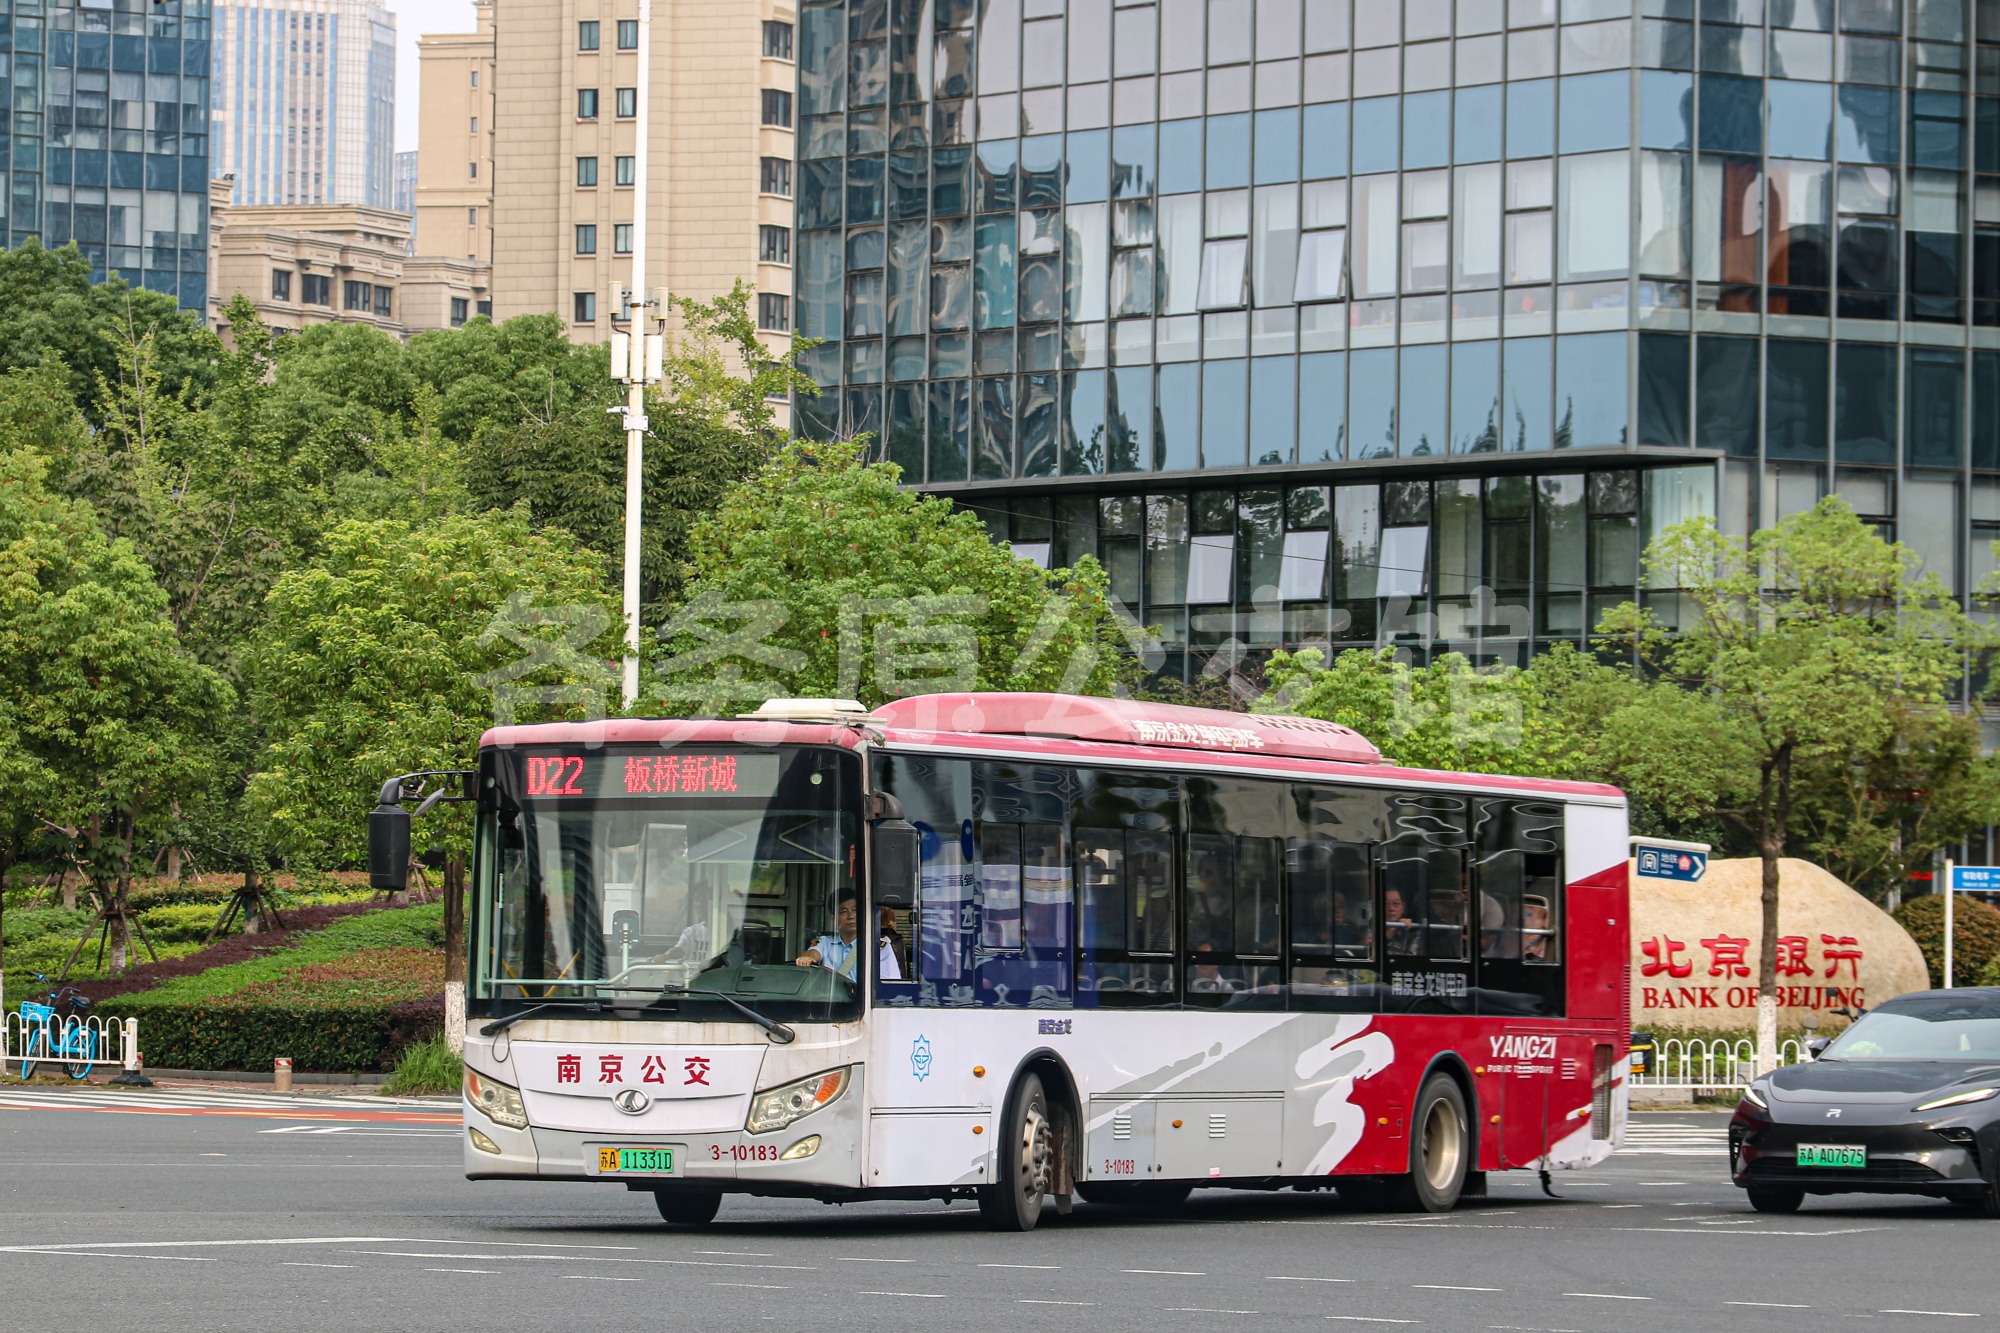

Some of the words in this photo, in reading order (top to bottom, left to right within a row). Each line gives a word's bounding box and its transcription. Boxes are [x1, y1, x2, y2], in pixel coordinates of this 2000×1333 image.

[527, 756, 584, 795] D22
[624, 755, 738, 793] 板桥新城
[1642, 987, 1719, 1009] BANK
[1727, 987, 1761, 1008] OF
[1775, 986, 1865, 1010] BEIJING
[1489, 1035, 1557, 1059] YANGZI
[557, 1054, 710, 1086] 南京公交
[1487, 1064, 1512, 1073] PUBLIC
[711, 1145, 777, 1161] 3-10183
[1105, 1159, 1135, 1174] 3-10183
